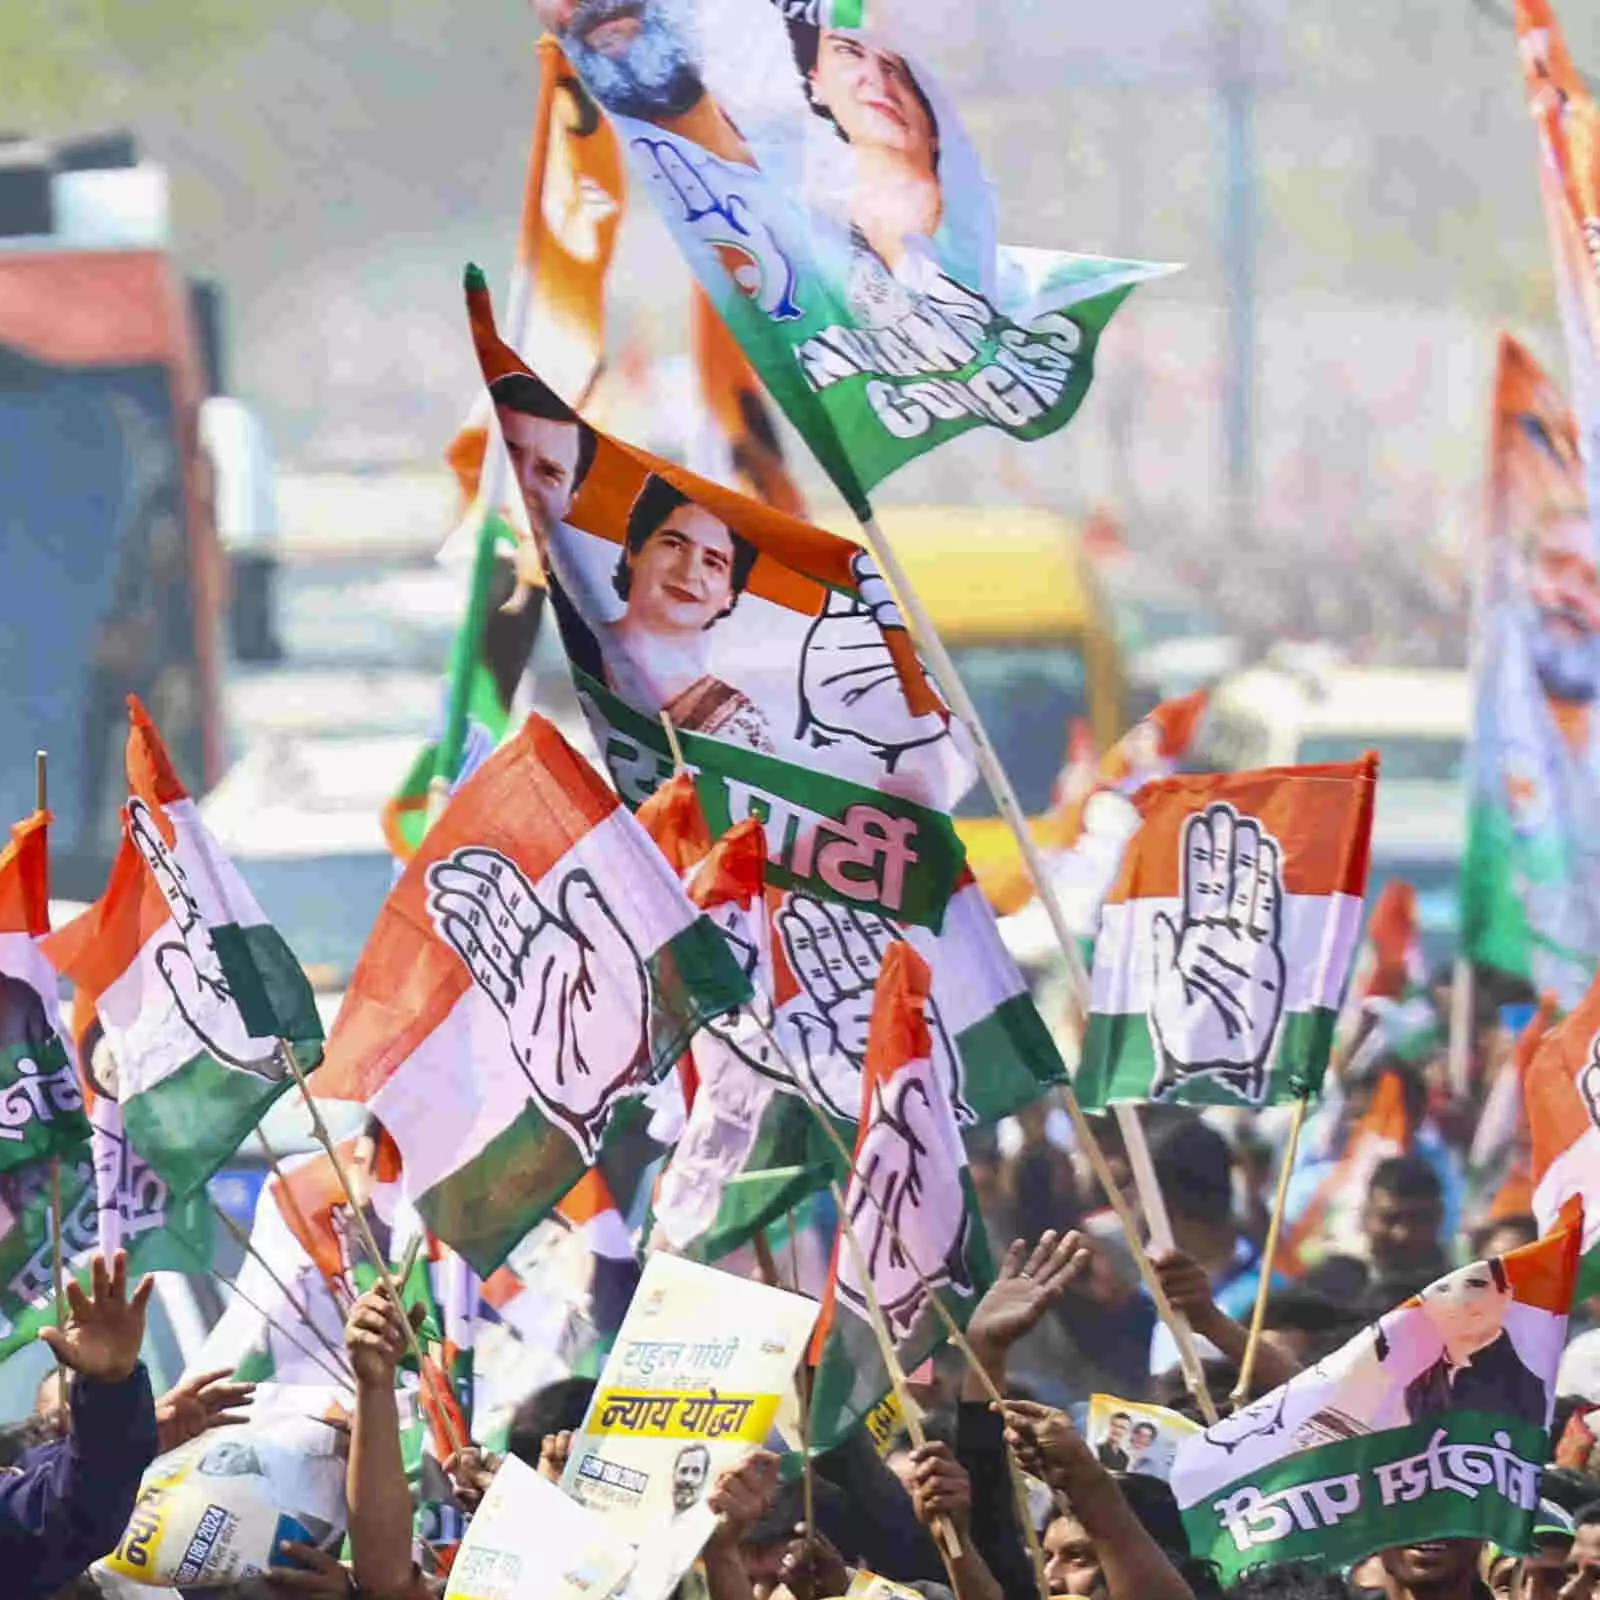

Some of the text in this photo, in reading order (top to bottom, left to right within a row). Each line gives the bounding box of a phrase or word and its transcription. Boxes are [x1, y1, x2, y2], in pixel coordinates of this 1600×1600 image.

[601, 1386, 755, 1437] न्याय योद्धा
[202, 1507, 227, 1541] 2024
